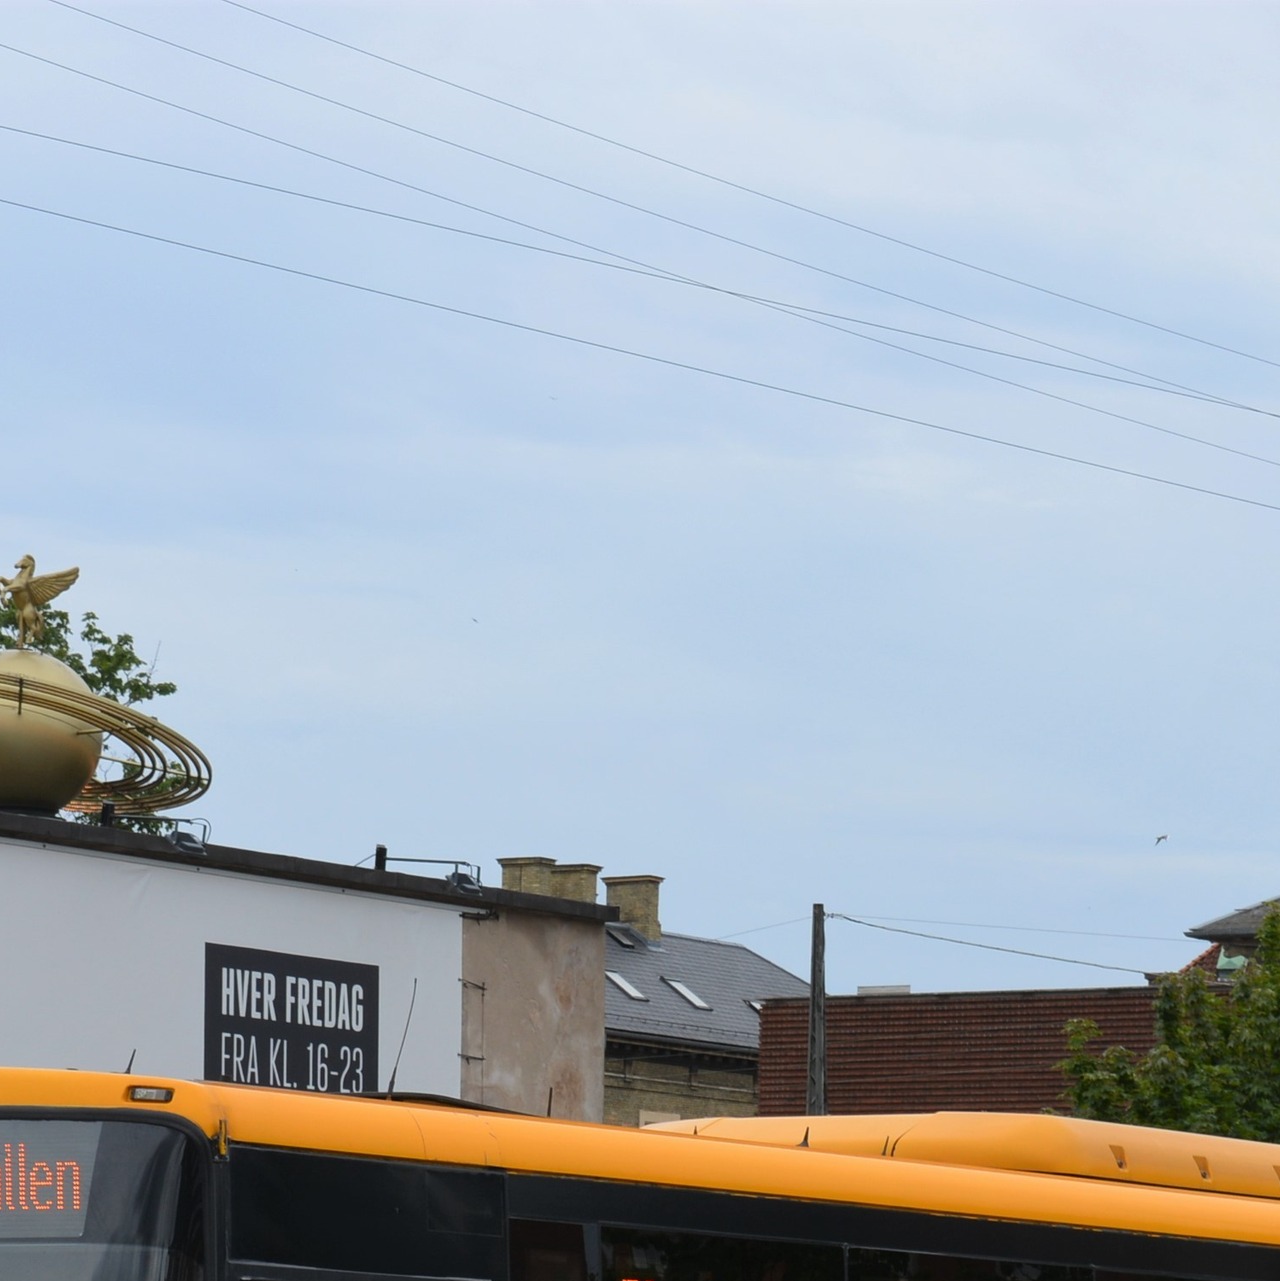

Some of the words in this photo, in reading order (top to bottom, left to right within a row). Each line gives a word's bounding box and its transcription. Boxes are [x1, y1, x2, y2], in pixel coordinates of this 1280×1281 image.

[221, 966, 277, 1022] HVER
[285, 975, 364, 1032] FREDAG
[221, 1031, 260, 1084] FRA
[269, 1037, 298, 1089] KL.
[306, 1042, 364, 1094] 16-23
